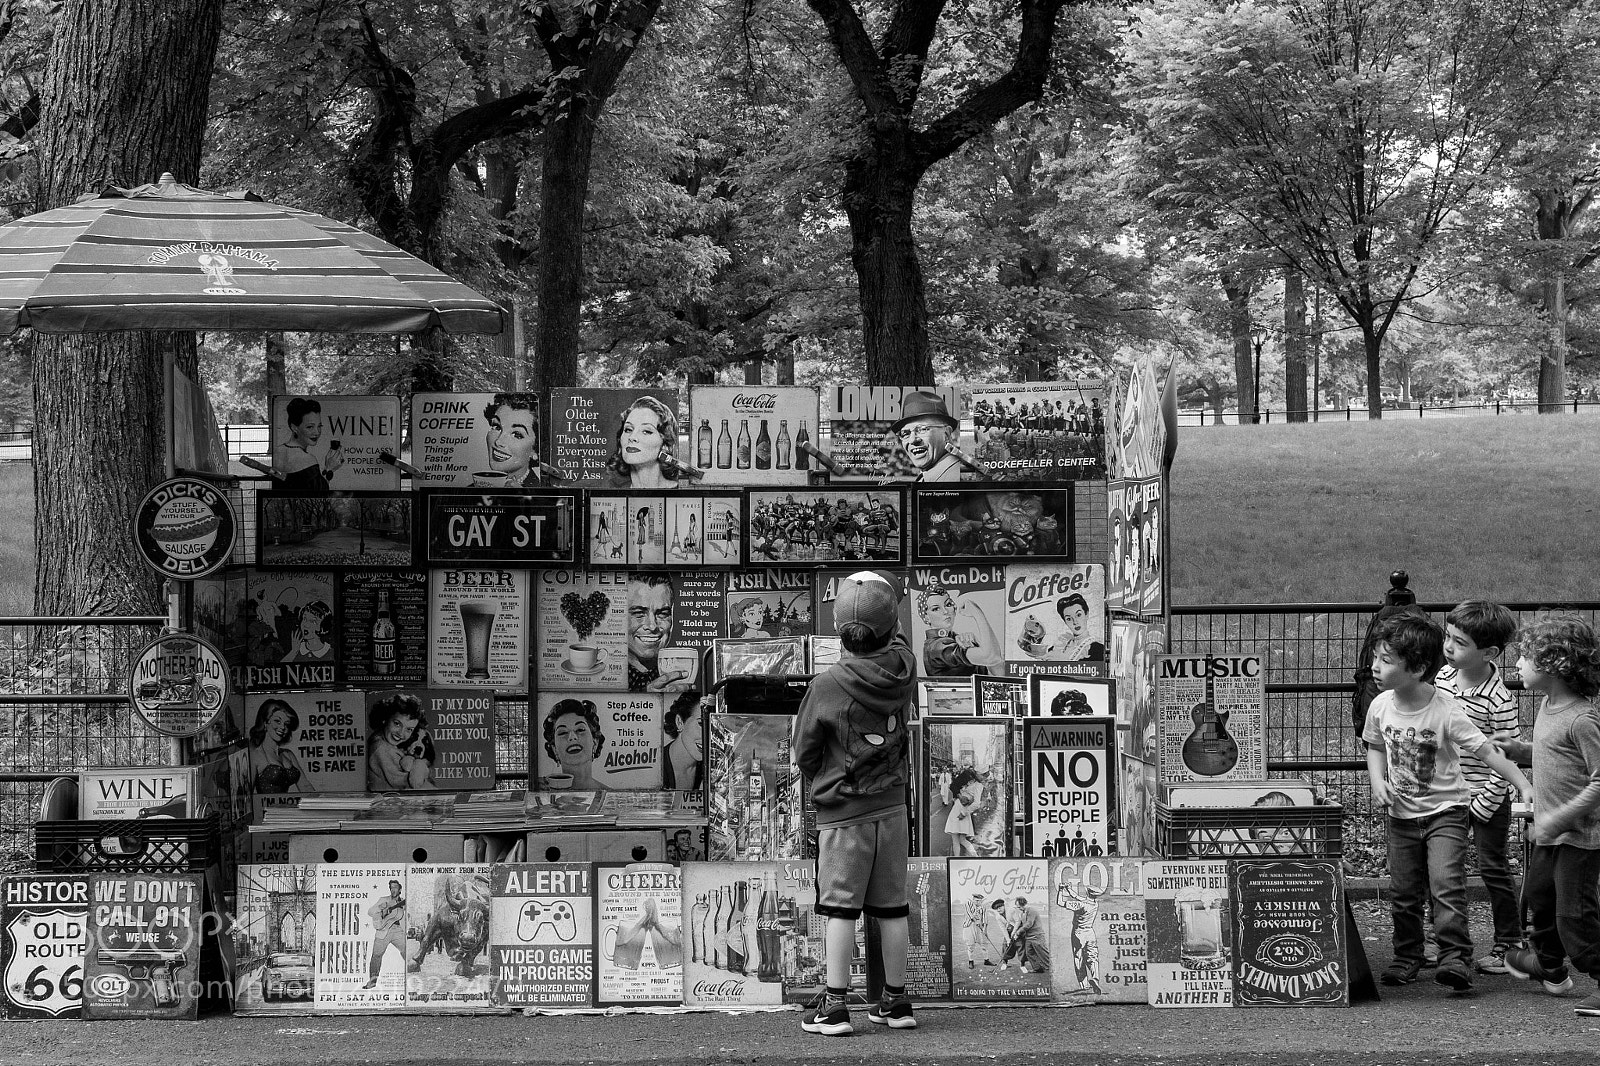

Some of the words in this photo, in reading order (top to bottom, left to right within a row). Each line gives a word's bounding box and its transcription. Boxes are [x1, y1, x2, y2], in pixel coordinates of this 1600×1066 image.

[148, 242, 196, 264] TOMMY
[200, 242, 278, 269] BAHAMA
[423, 402, 470, 414] DRINK
[571, 397, 593, 407] The
[565, 409, 599, 420] Older
[328, 416, 393, 436] WINE!
[419, 418, 475, 429] COFFEE
[575, 421, 600, 434] Get,
[424, 436, 437, 444] Do
[440, 436, 469, 446] Stupid
[556, 434, 577, 444] The
[580, 434, 607, 444] More
[366, 447, 394, 455] CLASSY
[424, 446, 454, 455] Things
[557, 446, 607, 458] Everyone
[347, 457, 373, 465] PEOPLE
[558, 458, 579, 468] Can
[583, 458, 606, 468] Kiss
[984, 460, 1053, 469] ROCKEFELLER
[1058, 458, 1096, 467] CENTER
[446, 464, 468, 472] More
[425, 473, 456, 482] Energy
[563, 470, 579, 481] My
[582, 470, 604, 480] Ass.
[152, 483, 218, 506] DICK'S
[449, 515, 497, 547] GAY
[512, 515, 546, 547] ST
[165, 544, 207, 555] SAUSAGE
[163, 556, 209, 574] DELI
[443, 571, 515, 588] BEER
[543, 570, 626, 585] COFFEE
[728, 571, 764, 591] FISH
[915, 569, 938, 586] We
[940, 569, 966, 585] Can
[969, 568, 989, 584] Do
[992, 566, 1005, 583] It!
[1008, 565, 1092, 608] Coffee!
[695, 600, 720, 609] going
[675, 639, 701, 647] watch
[375, 644, 394, 659] BEER
[140, 656, 185, 680] MOTHER
[189, 657, 220, 680] ROAD
[1018, 664, 1046, 676] you're
[1047, 665, 1062, 674] not
[1063, 664, 1100, 677] shaking,
[1160, 657, 1260, 679] MUSIC
[247, 665, 282, 687] FISH
[316, 701, 342, 712] THE
[431, 698, 444, 711] IF
[446, 698, 465, 710] MY
[466, 698, 490, 710] DOG
[607, 701, 627, 710] Step
[629, 700, 654, 709] Aside
[308, 714, 354, 727] BOOBS
[438, 713, 485, 726] DOESN'T
[612, 712, 652, 722] Coffee.
[300, 729, 325, 741] ARE
[328, 728, 364, 741] REAL,
[434, 728, 463, 741] LIKE
[465, 728, 491, 742] YOU,
[617, 728, 635, 737] This
[1051, 731, 1104, 746] WARNING
[618, 738, 635, 747] Job
[637, 738, 650, 747] for
[298, 746, 324, 758] THE
[327, 745, 365, 757] SMILE
[449, 751, 482, 764] DON'T
[604, 748, 658, 768] Alcohol!
[308, 761, 321, 773] IS
[324, 760, 356, 773] FAKE
[435, 767, 463, 779] LIKE
[466, 766, 491, 778] YOU.
[1037, 751, 1099, 789] NO
[97, 777, 173, 801] WINE
[1038, 791, 1099, 807] STUPID
[1037, 809, 1100, 824] PEOPLE
[784, 863, 811, 881] San
[920, 862, 947, 871] BEST
[1162, 865, 1206, 875] EVERYONE
[504, 871, 588, 894] ALERT!
[958, 865, 998, 895] Play
[1002, 865, 1041, 895] Golf
[1147, 877, 1195, 890] SOMETHING
[1196, 877, 1207, 889] TO
[7, 881, 88, 902] HISTOR
[94, 880, 127, 902] WE
[133, 880, 196, 903] DON'T
[1254, 901, 1321, 911] WHISKEY
[95, 905, 149, 928] CALL
[155, 905, 191, 928] 911
[328, 903, 360, 936] ELVIS
[1101, 912, 1120, 921] an
[33, 922, 81, 939] OLD
[1253, 919, 1323, 932] Tennessee
[126, 933, 142, 943] WE
[142, 933, 160, 943] USE
[25, 944, 86, 958] ROUTE
[319, 940, 369, 974] PRESLEY
[500, 950, 545, 964] VIDEO
[549, 950, 592, 964] GAME
[1115, 946, 1146, 961] just
[1112, 960, 1147, 971] hard
[499, 966, 514, 980] IN
[519, 966, 593, 980] PROGRESS
[1105, 974, 1120, 984] to
[1181, 970, 1232, 981] BELIEVE
[1237, 961, 1300, 998] DANIEL'S
[1301, 961, 1342, 992] JACK
[24, 964, 83, 1001] 66
[503, 984, 563, 993] UNAUTHORIZED
[564, 984, 590, 993] ENTRY
[1184, 982, 1200, 991] I'LL
[1202, 981, 1231, 991] HAVE...
[319, 994, 336, 1002] FRI
[346, 994, 365, 1002] SAT
[368, 994, 390, 1002] AUG
[409, 991, 430, 1002] They
[430, 991, 453, 1001] don't
[453, 992, 481, 1002] expect
[507, 994, 527, 1002] WILL
[528, 994, 539, 1002] BE
[540, 994, 586, 1002] ELIMINATED
[1154, 992, 1220, 1004] ANOTHER
